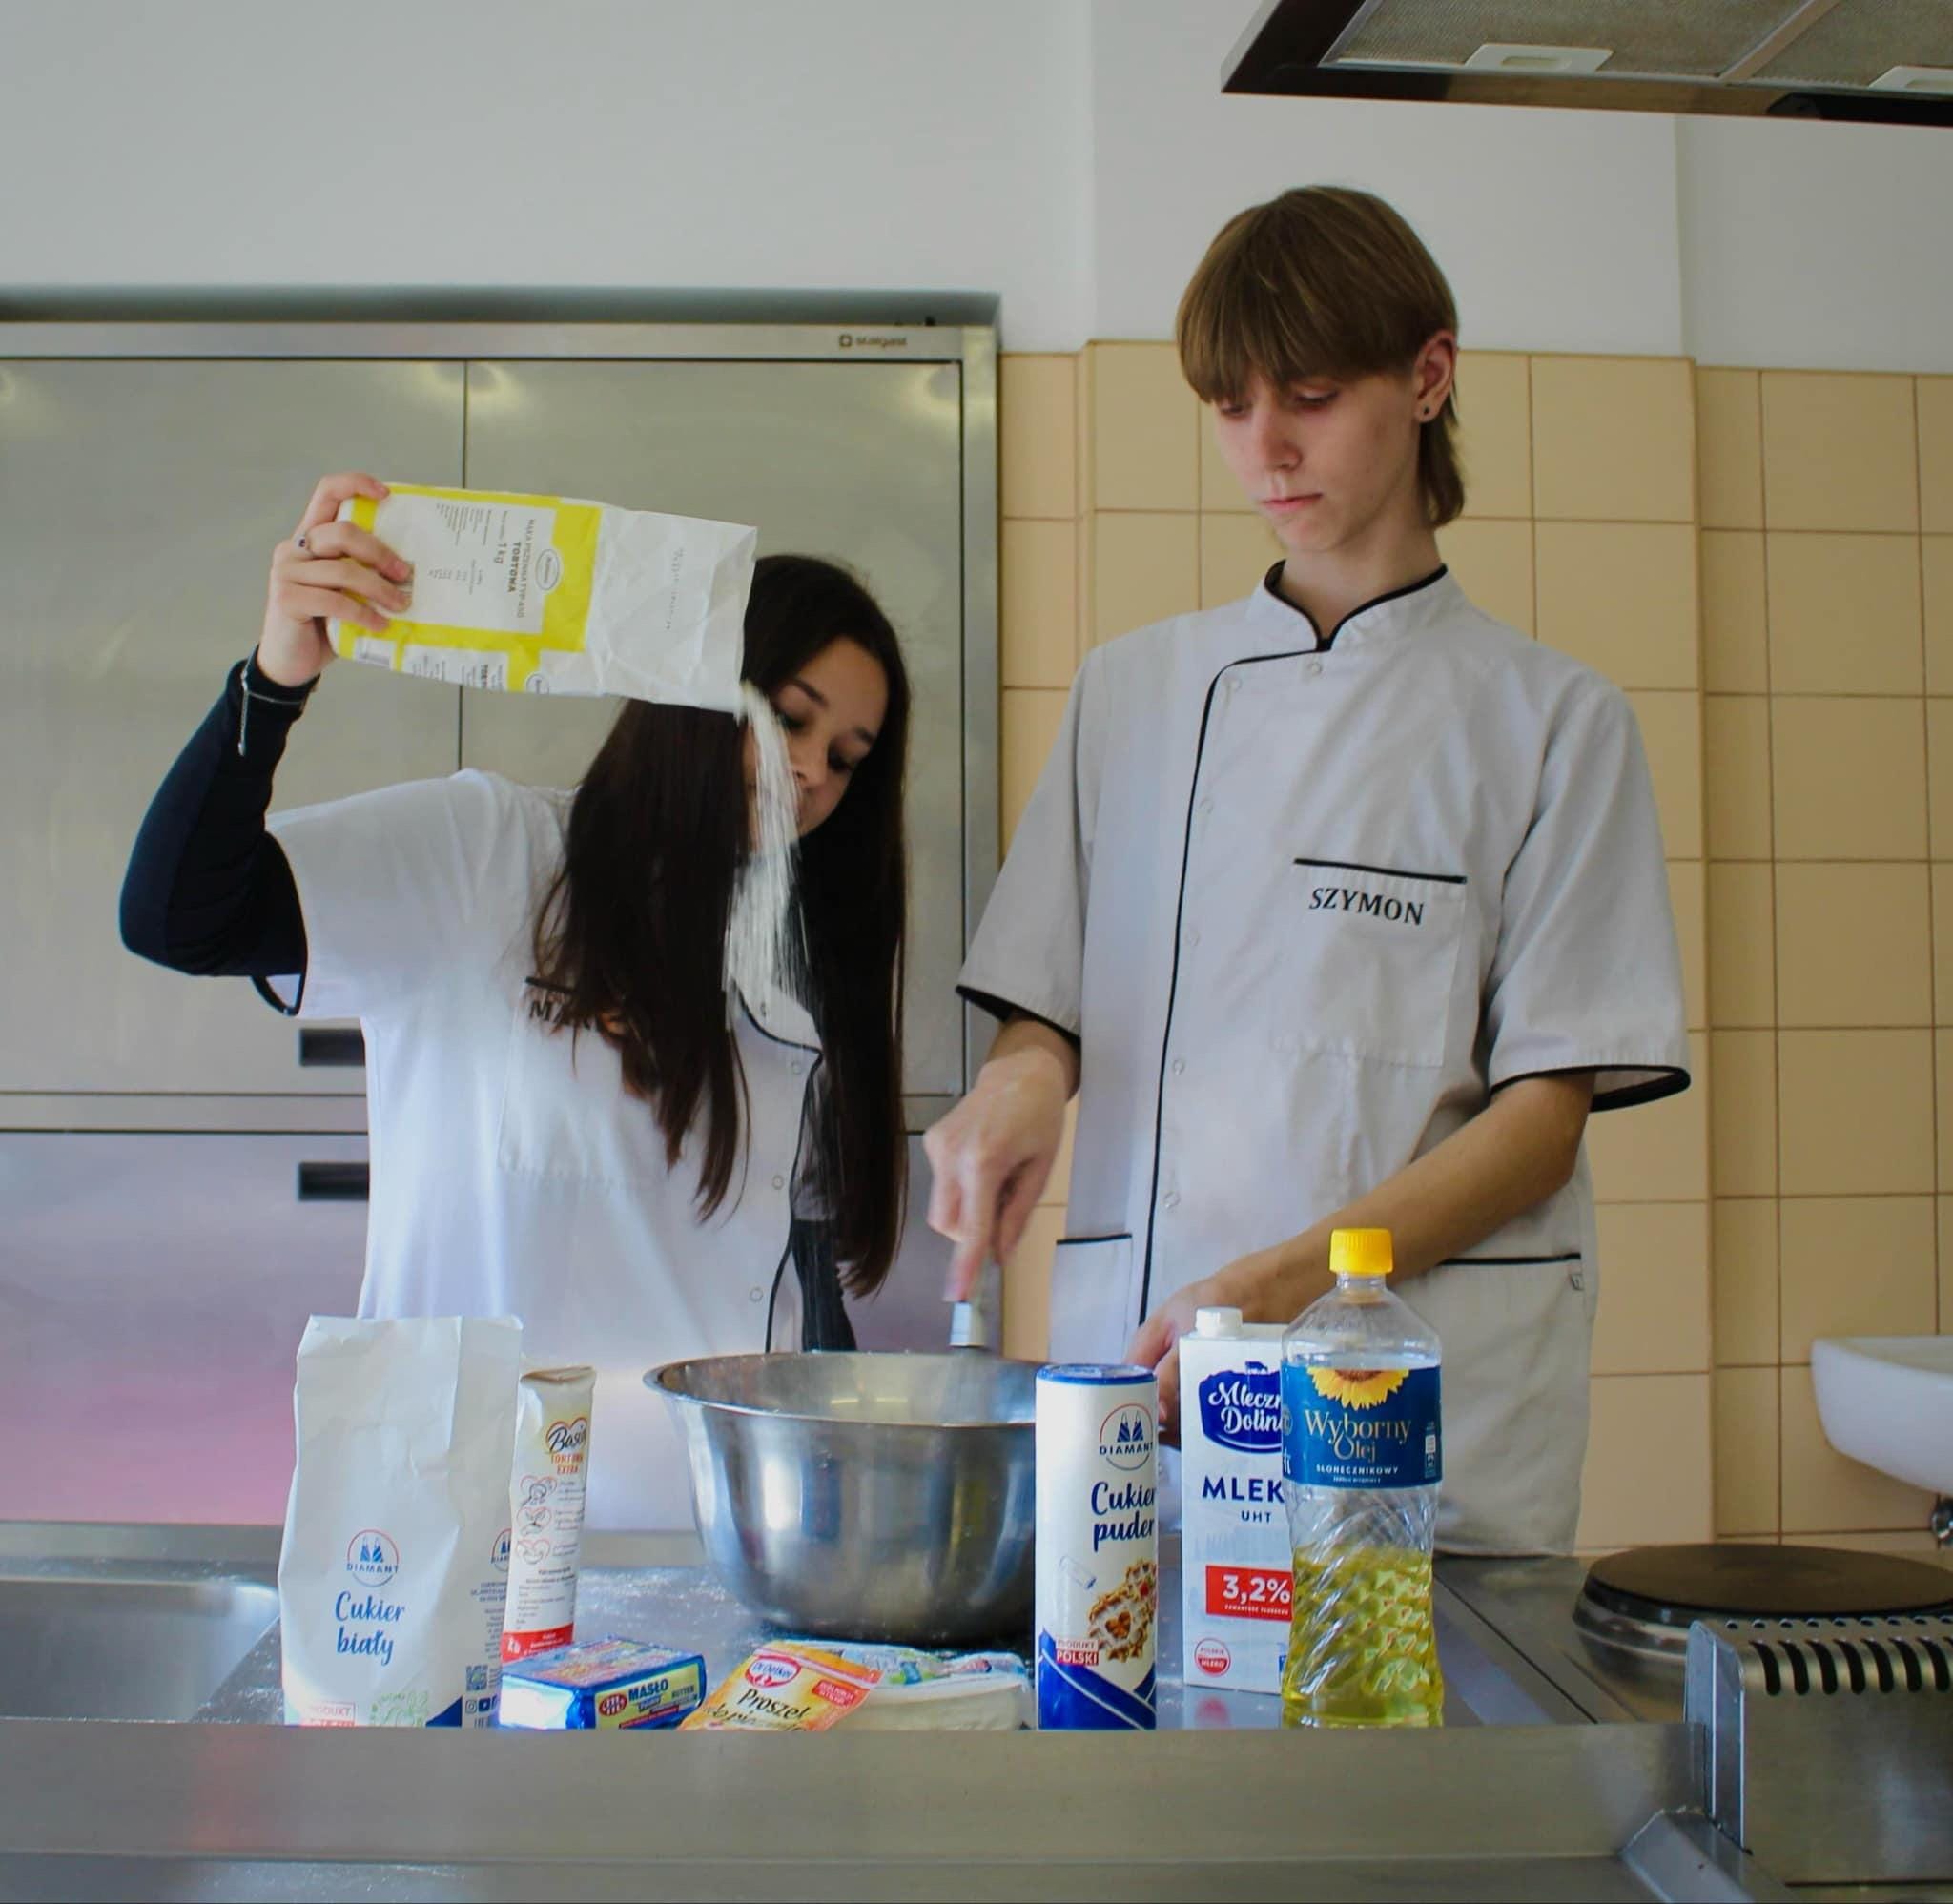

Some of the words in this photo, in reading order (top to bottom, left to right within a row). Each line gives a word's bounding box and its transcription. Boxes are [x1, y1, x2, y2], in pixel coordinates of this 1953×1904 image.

[507, 541, 521, 592] TORTOWA
[1309, 888, 1424, 926] SZYMON
[1208, 1382, 1282, 1410] Mleczn
[1305, 1409, 1411, 1445] Wyborny
[1100, 1443, 1154, 1456] DIAMANT
[1335, 1431, 1375, 1463] Olej
[1091, 1481, 1156, 1515] Cukier
[1202, 1475, 1285, 1504] MLEK
[1094, 1510, 1155, 1553] puder
[1242, 1510, 1272, 1525] UHT
[346, 1563, 399, 1574] DIAMANT
[1222, 1574, 1291, 1605] 3,2%
[336, 1590, 405, 1622] Cukier
[337, 1626, 395, 1667] biały
[1057, 1650, 1098, 1664] POLSKI
[628, 1678, 669, 1701] MASŁO
